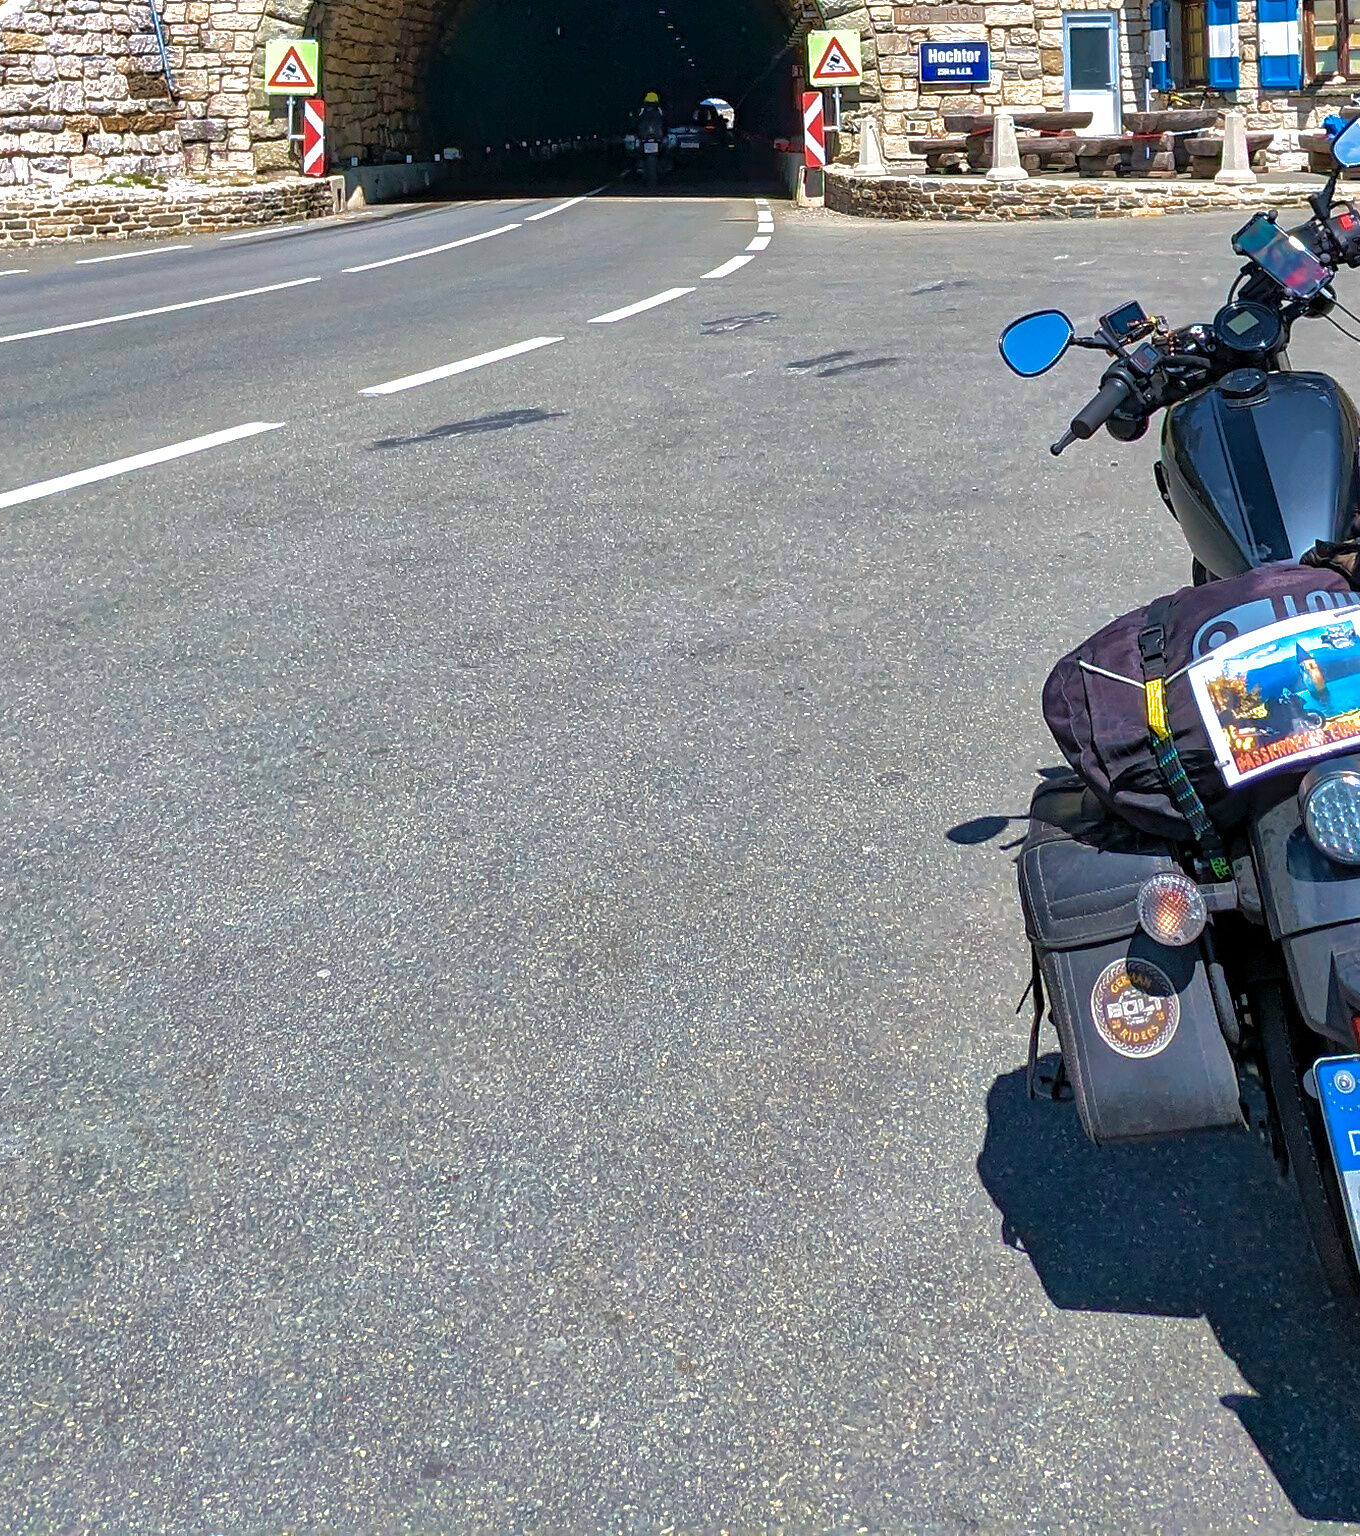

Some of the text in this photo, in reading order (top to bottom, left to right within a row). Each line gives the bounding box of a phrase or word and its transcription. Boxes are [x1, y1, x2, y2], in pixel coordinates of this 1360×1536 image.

[945, 6, 979, 21] 1935
[927, 48, 981, 64] Hochtor
[1106, 996, 1165, 1018] BOLT
[1119, 1024, 1160, 1042] RIDERS
